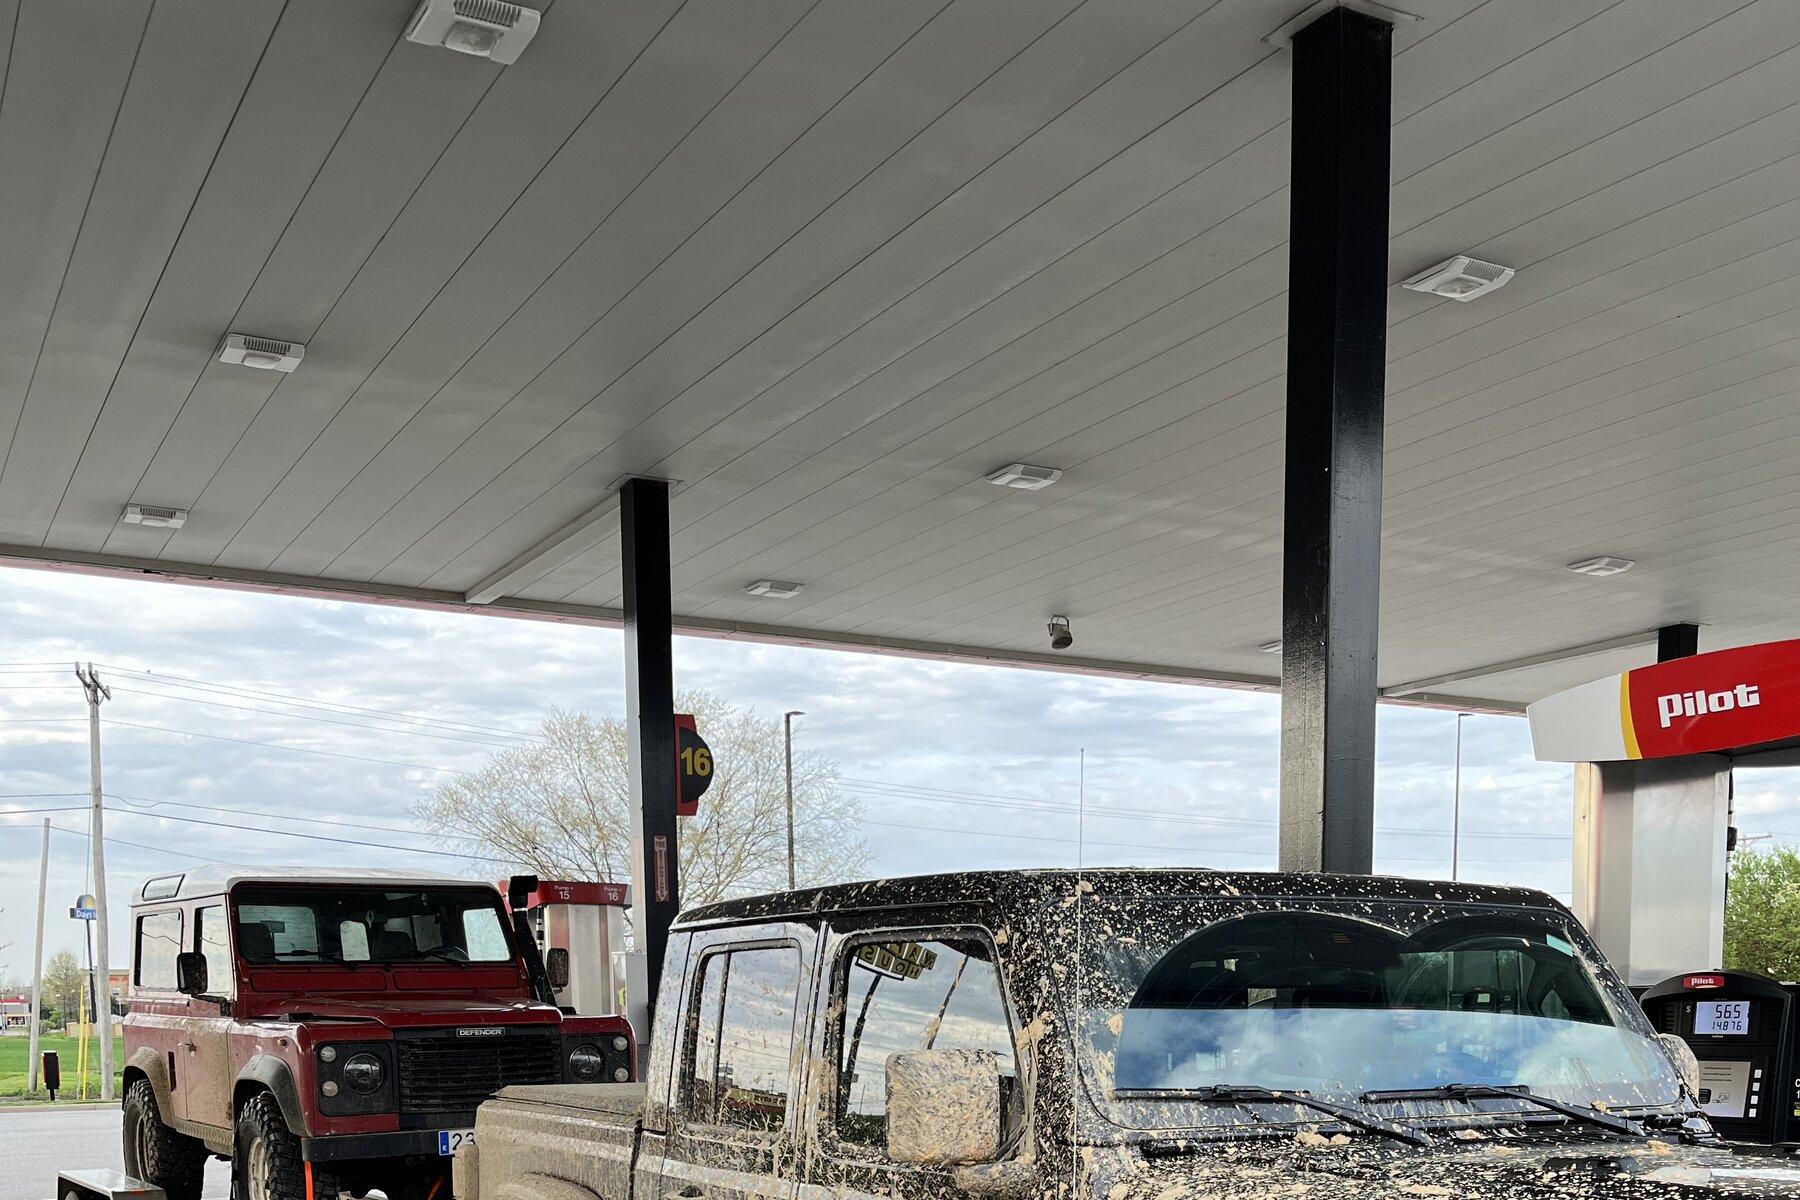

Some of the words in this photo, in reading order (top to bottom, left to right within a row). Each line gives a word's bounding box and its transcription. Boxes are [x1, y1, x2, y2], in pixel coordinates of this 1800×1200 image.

[1657, 683, 1760, 729] Pilot
[680, 747, 711, 776] 16
[558, 890, 571, 900] 15
[608, 892, 619, 902] 16
[1691, 978, 1714, 986] Pilot
